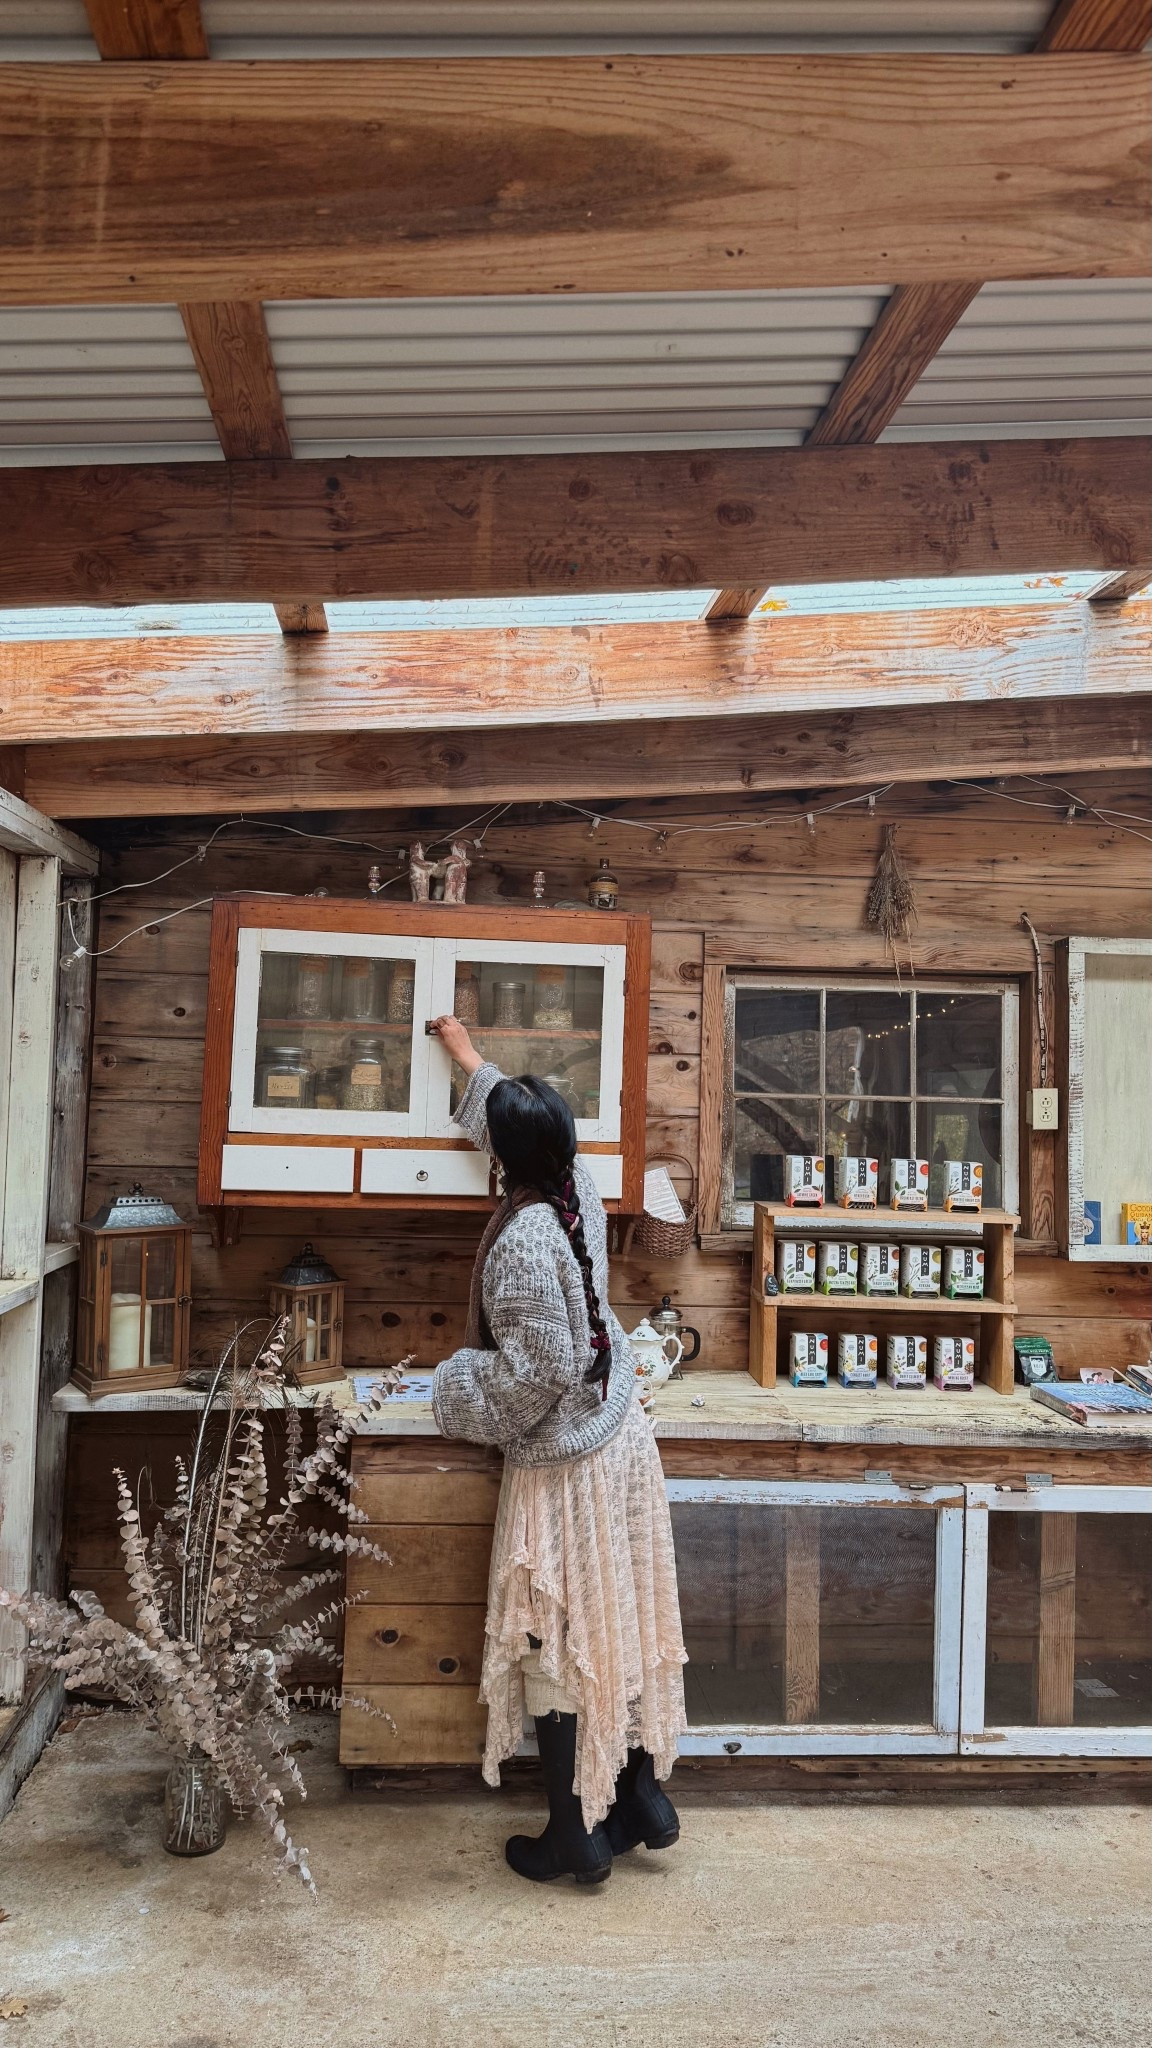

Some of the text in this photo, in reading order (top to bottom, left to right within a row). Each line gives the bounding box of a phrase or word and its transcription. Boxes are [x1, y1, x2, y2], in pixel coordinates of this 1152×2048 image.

[908, 1163, 916, 1186] NUMI
[962, 1165, 970, 1188] NUMI
[796, 1246, 804, 1269] NUMI
[880, 1249, 888, 1271] NUMI
[921, 1251, 929, 1273] NUMI
[965, 1252, 973, 1274] NUMI
[808, 1338, 816, 1362] NUMI
[857, 1339, 865, 1362] NUMI
[907, 1341, 915, 1364] NUMI
